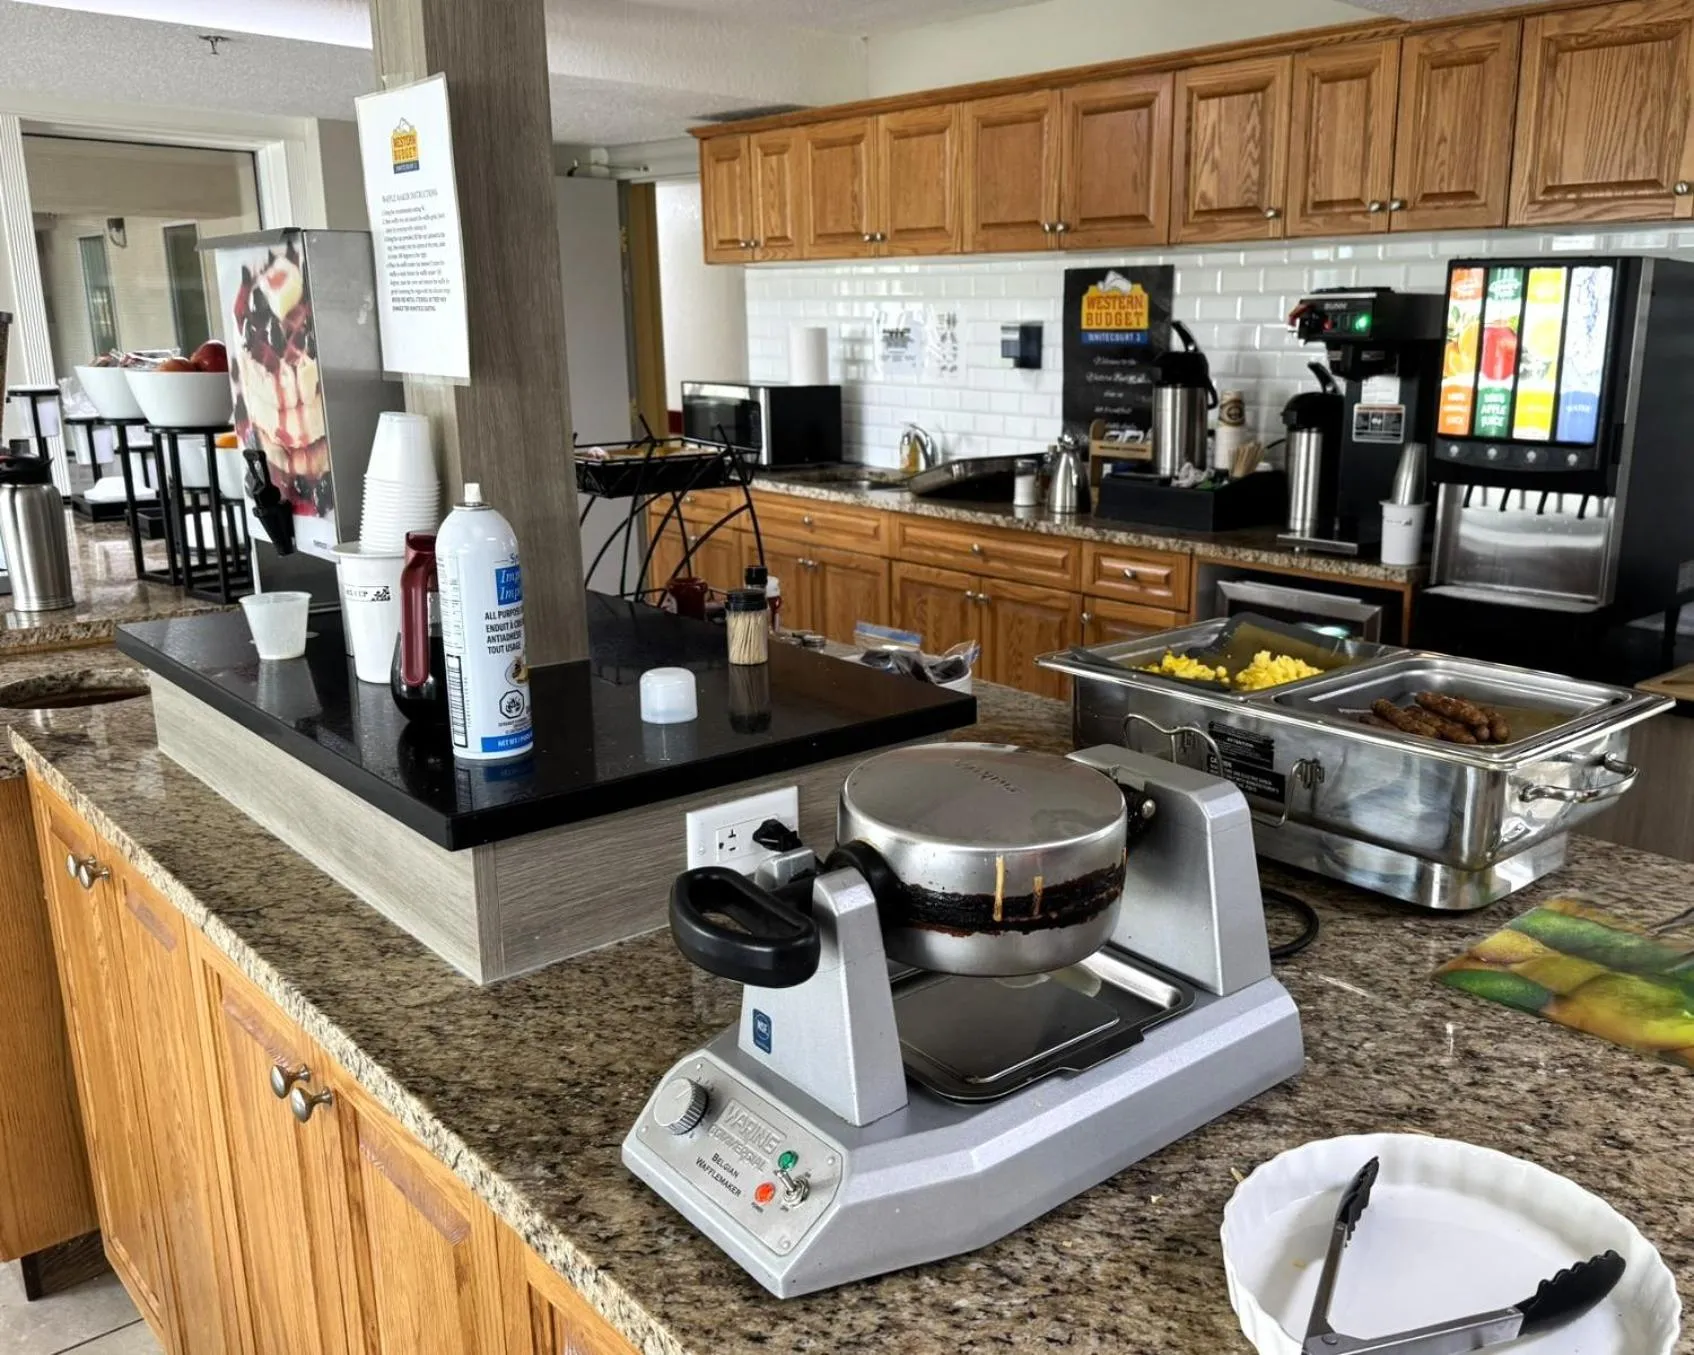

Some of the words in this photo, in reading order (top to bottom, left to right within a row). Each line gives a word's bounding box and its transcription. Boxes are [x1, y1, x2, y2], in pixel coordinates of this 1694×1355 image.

[1087, 294, 1144, 310] WESTERN
[1086, 312, 1144, 327] BUDGET
[485, 611, 497, 620] ALL
[488, 645, 504, 655] TOUT
[725, 1103, 781, 1155] WARING
[712, 1153, 739, 1178] BELGIAN
[696, 1156, 742, 1197] WAFFLEMAKER
